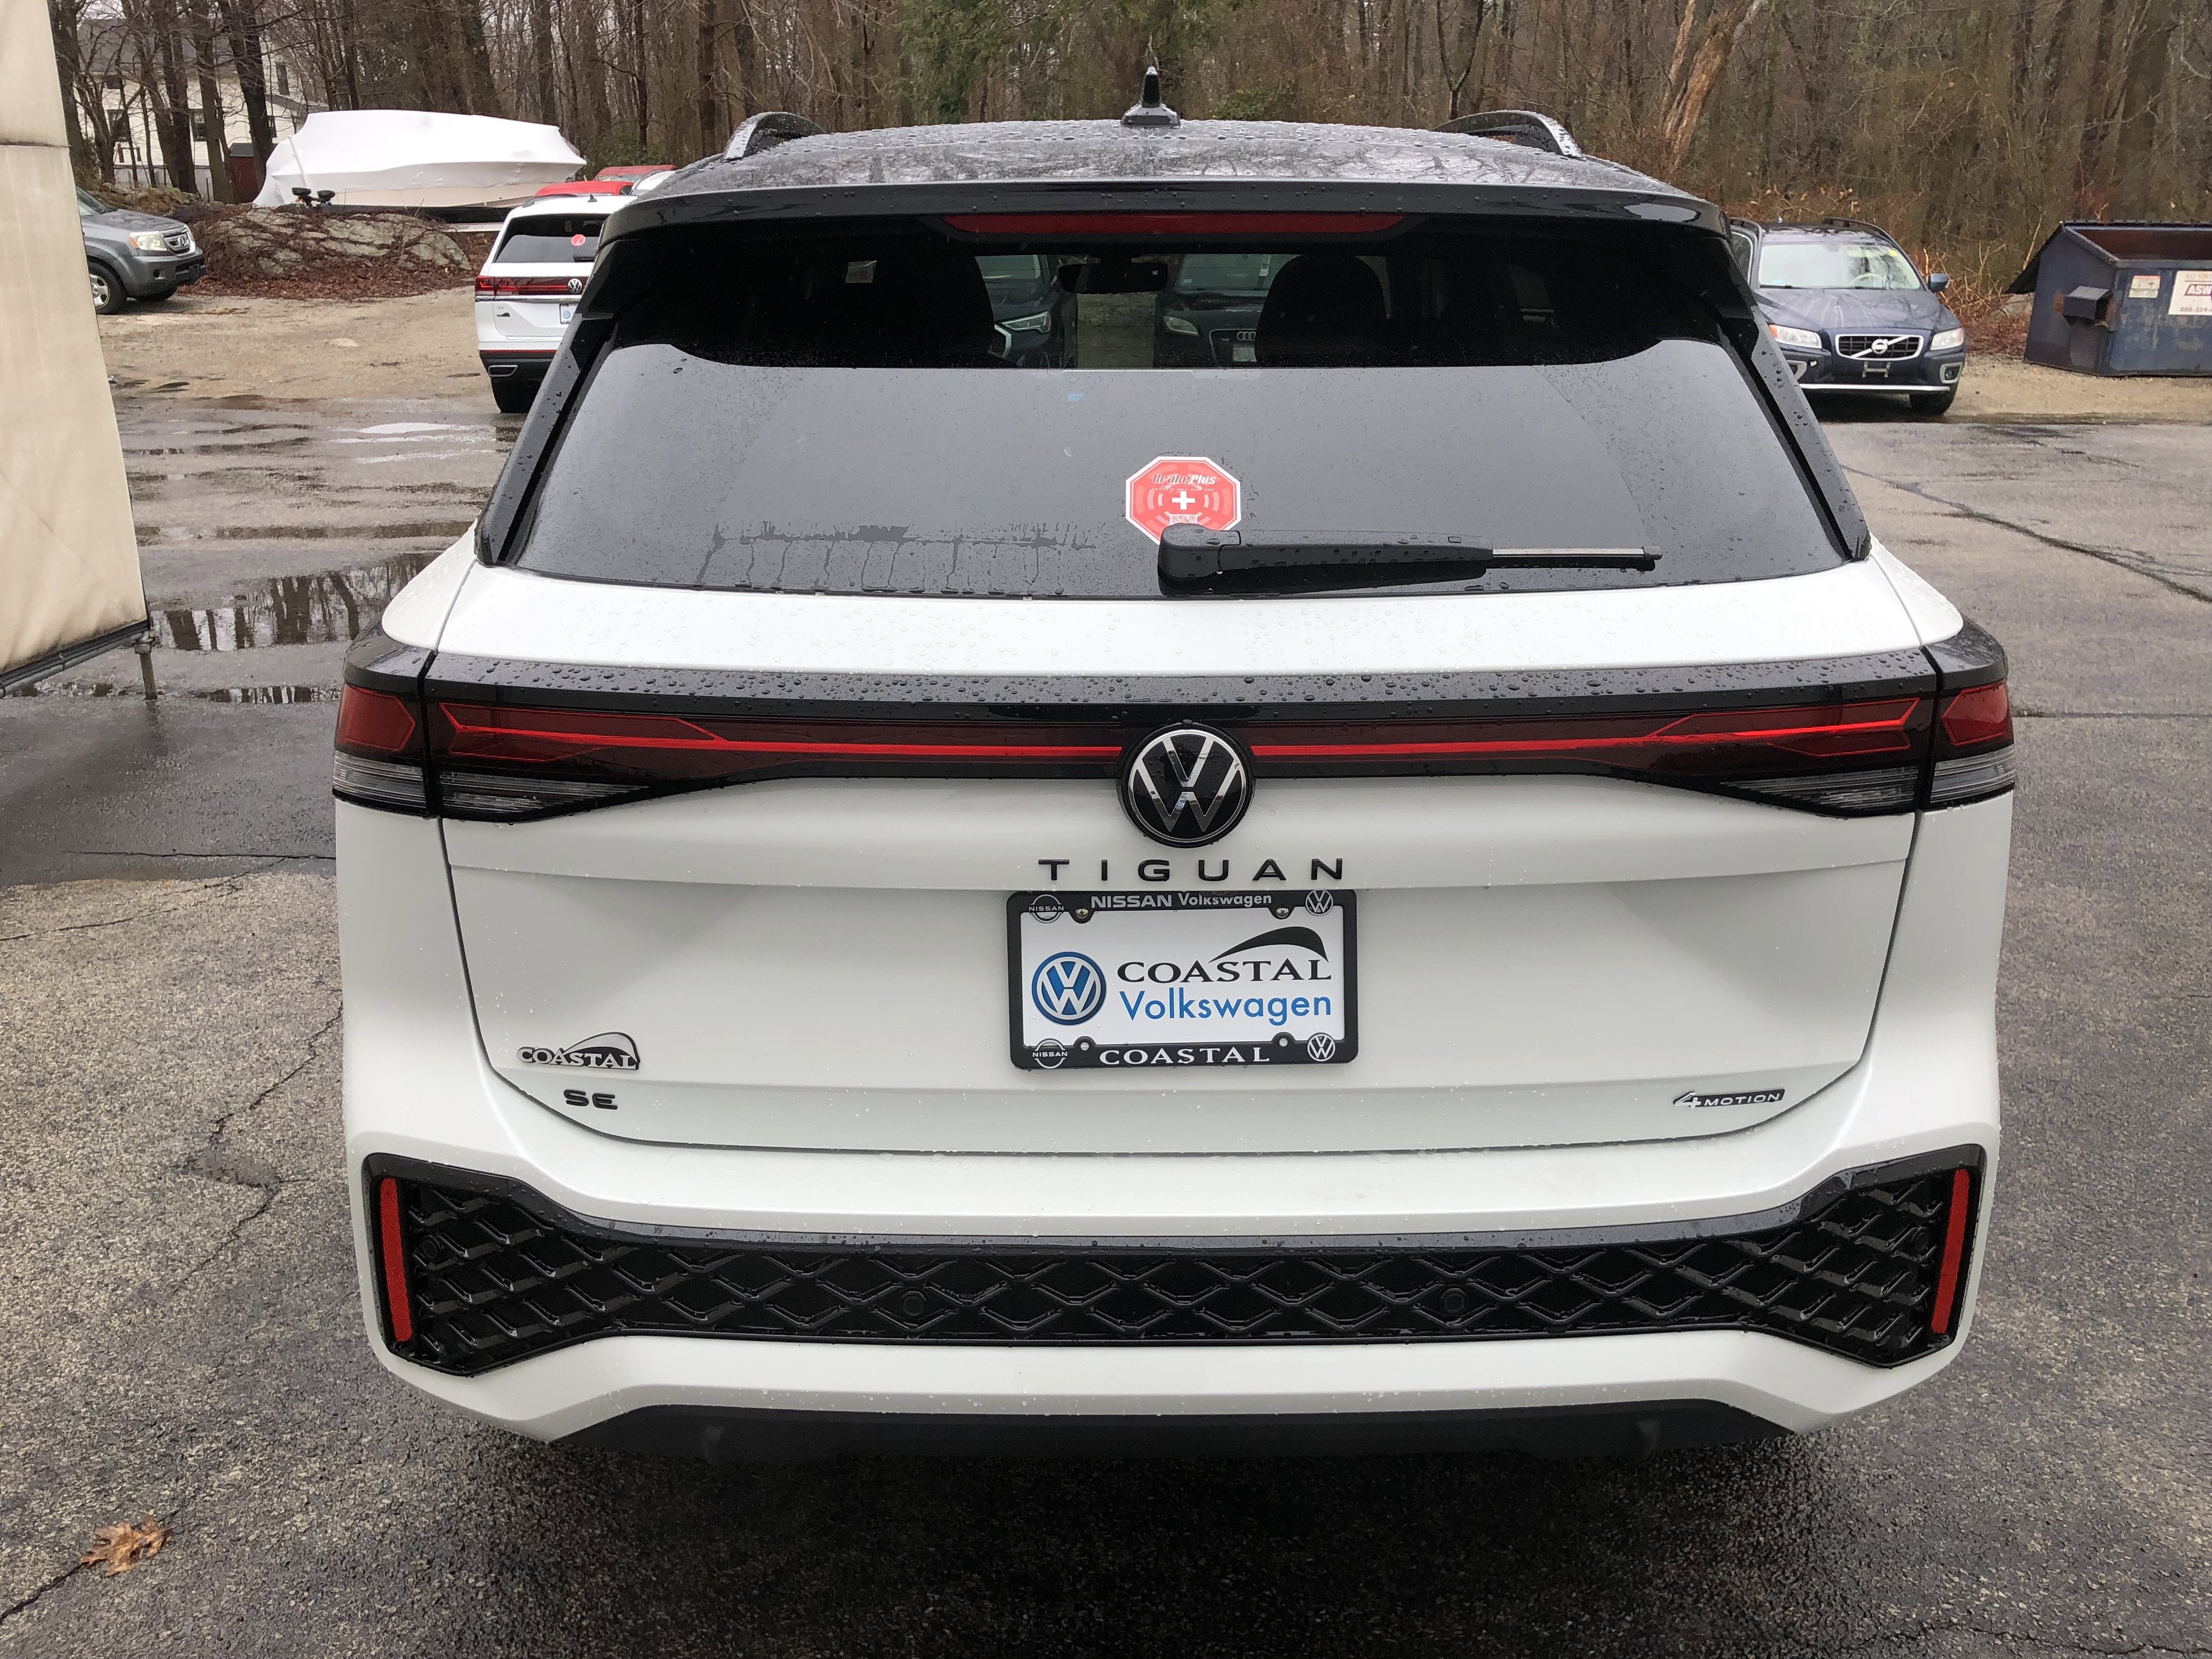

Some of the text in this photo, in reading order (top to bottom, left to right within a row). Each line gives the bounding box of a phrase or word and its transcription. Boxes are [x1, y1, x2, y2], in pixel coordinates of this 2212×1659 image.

[1038, 859, 1343, 882] TIGUAN
[1091, 892, 1272, 909] NISSAN Volkswagen
[1117, 958, 1331, 984] COASTAL
[1119, 987, 1331, 1026] Volkswagen
[517, 1046, 637, 1070] COASTAL
[1099, 1047, 1270, 1065] COASTAL
[563, 1089, 618, 1110] SE
[1673, 1092, 1781, 1109] 4MOTION
